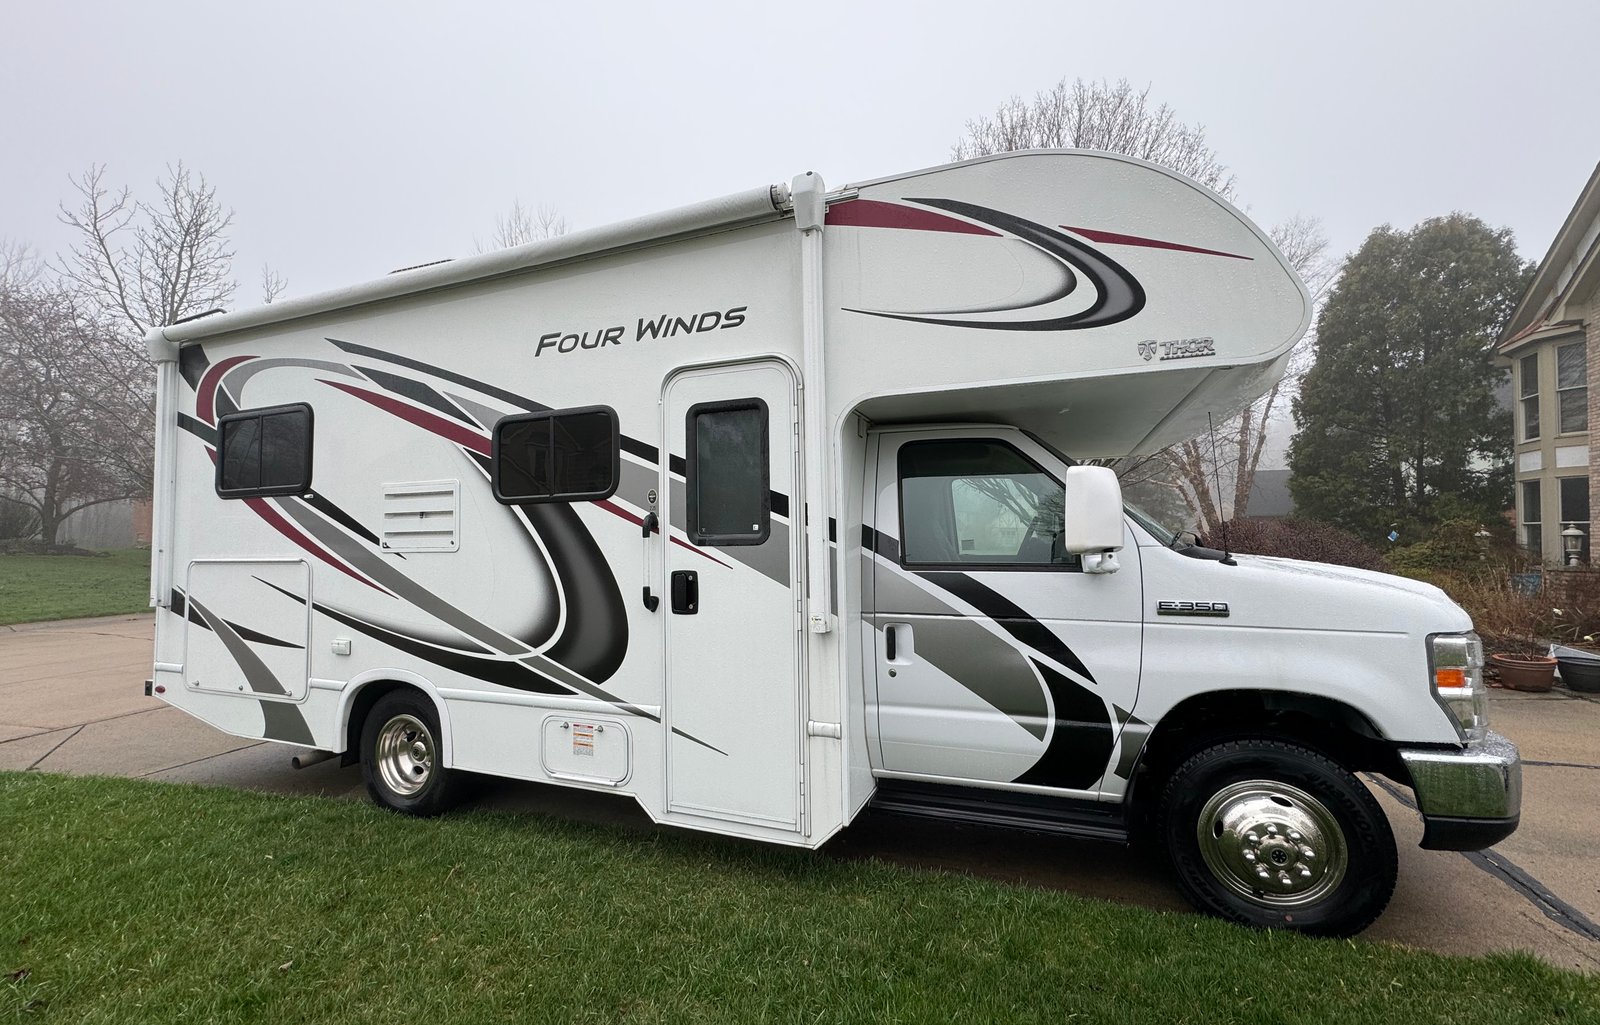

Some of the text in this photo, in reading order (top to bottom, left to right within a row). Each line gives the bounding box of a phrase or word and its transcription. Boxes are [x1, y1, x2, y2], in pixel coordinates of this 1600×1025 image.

[535, 306, 748, 357] FOUR WINDS
[1160, 336, 1215, 356] THOR
[1157, 600, 1229, 612] E-350
